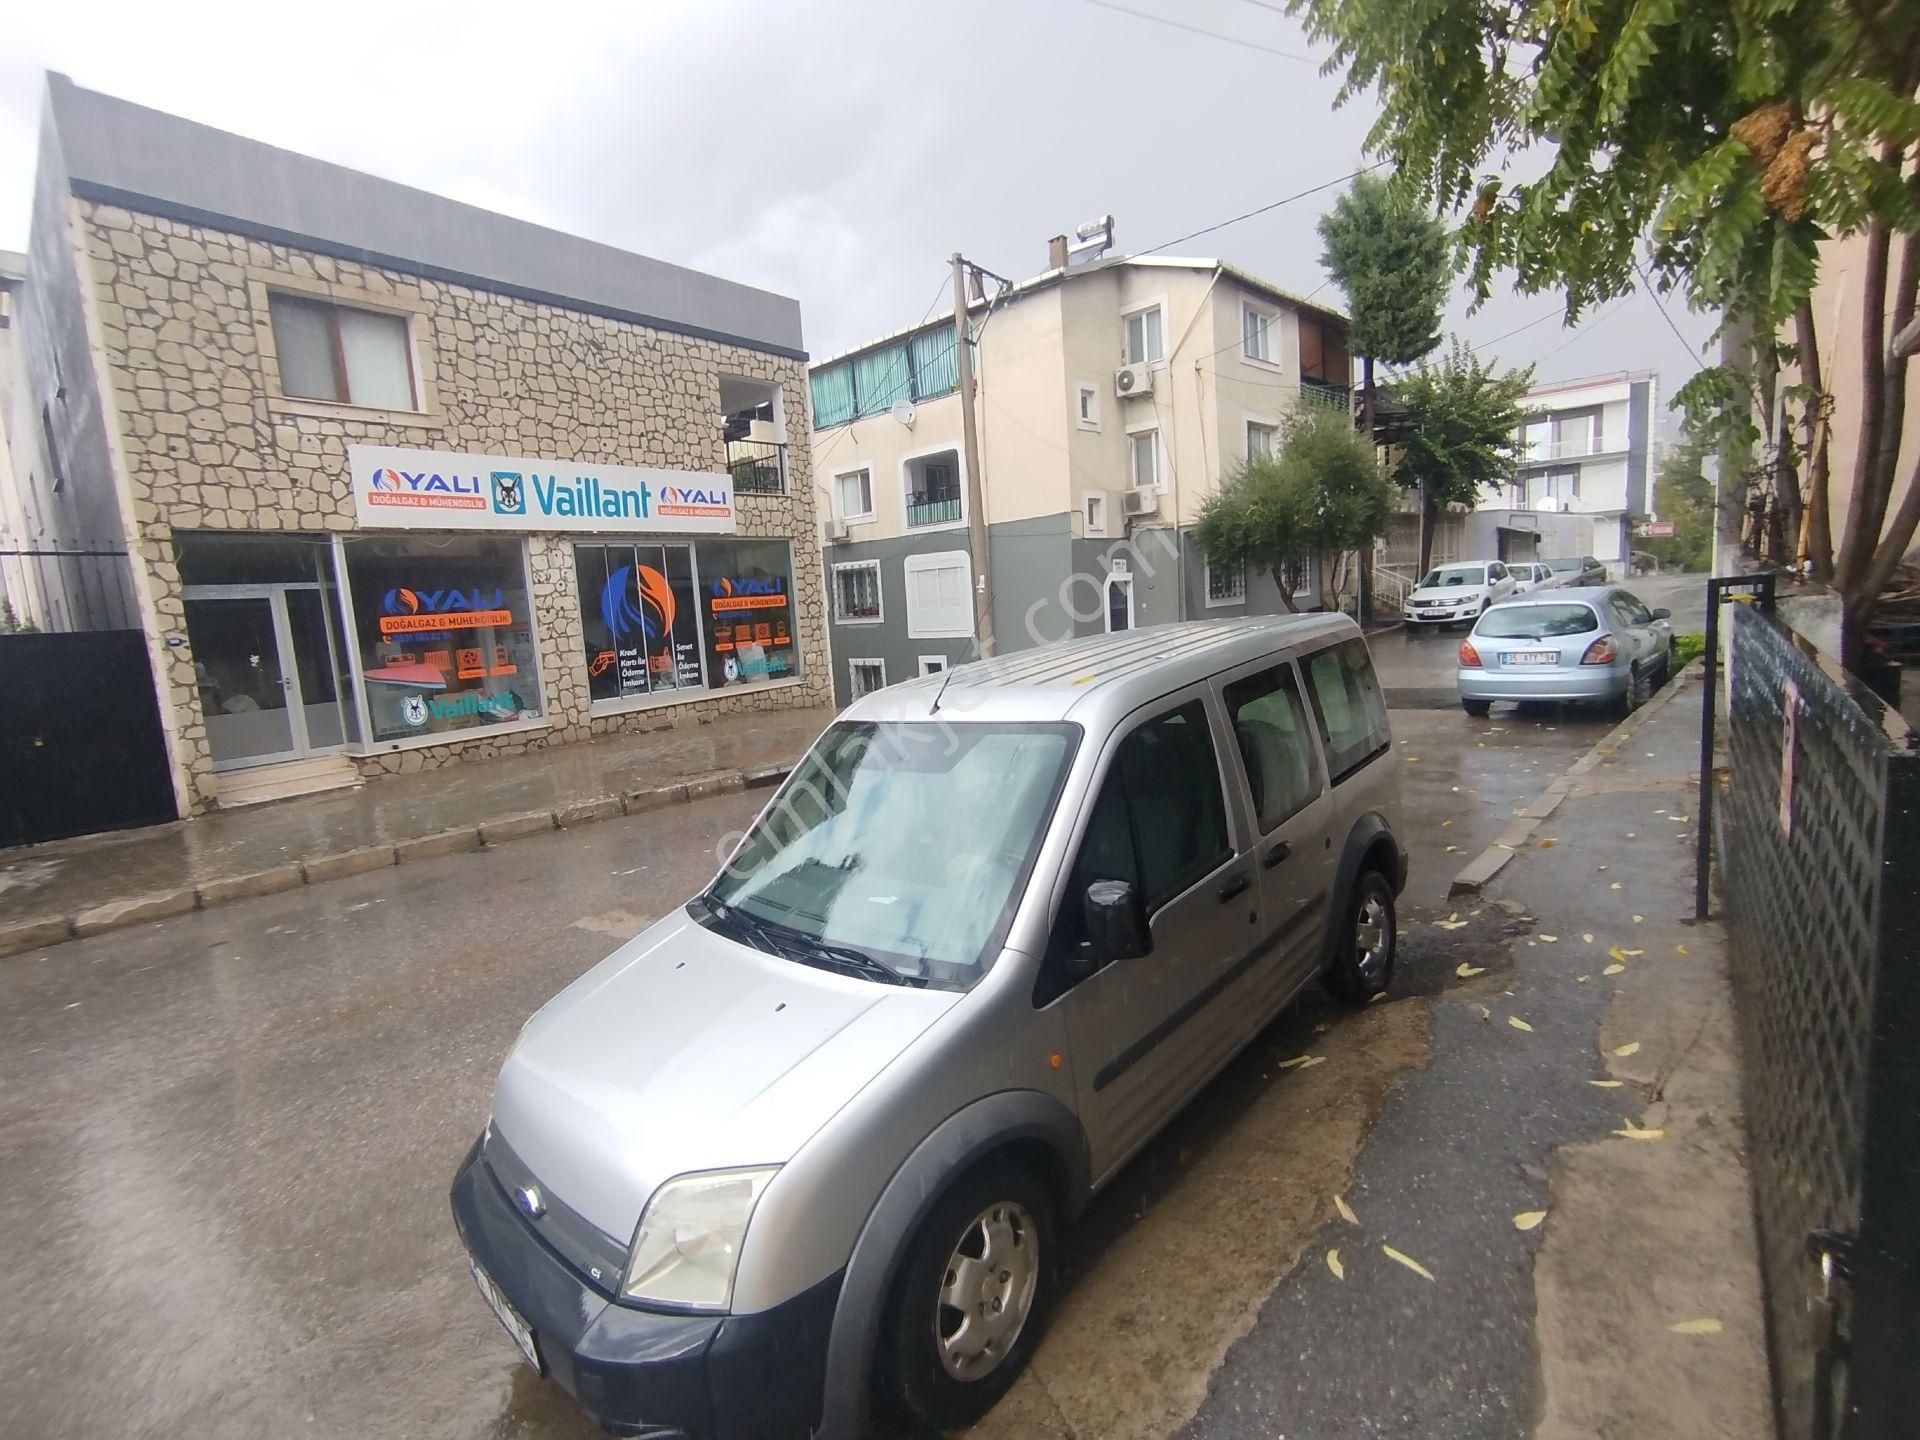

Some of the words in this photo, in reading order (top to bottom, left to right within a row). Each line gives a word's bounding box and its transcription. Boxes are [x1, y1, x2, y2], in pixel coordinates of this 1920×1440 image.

[531, 474, 652, 518] Vaillant
[372, 494, 419, 506] DOĞALGAZ
[429, 498, 485, 509] MÜHENDİSLİK
[660, 506, 689, 516] DOĞALGAZ
[697, 508, 729, 517] MÜHENDİSLİK
[714, 600, 743, 609] DOĞALGAZ
[386, 618, 437, 630] DOĞALGAZ
[676, 643, 693, 651] Senet
[620, 648, 637, 657] Kredi
[620, 659, 637, 667] Kartı
[678, 661, 699, 671] Ödeme
[622, 668, 645, 678] Ödeme
[428, 692, 515, 720] Vaillant
